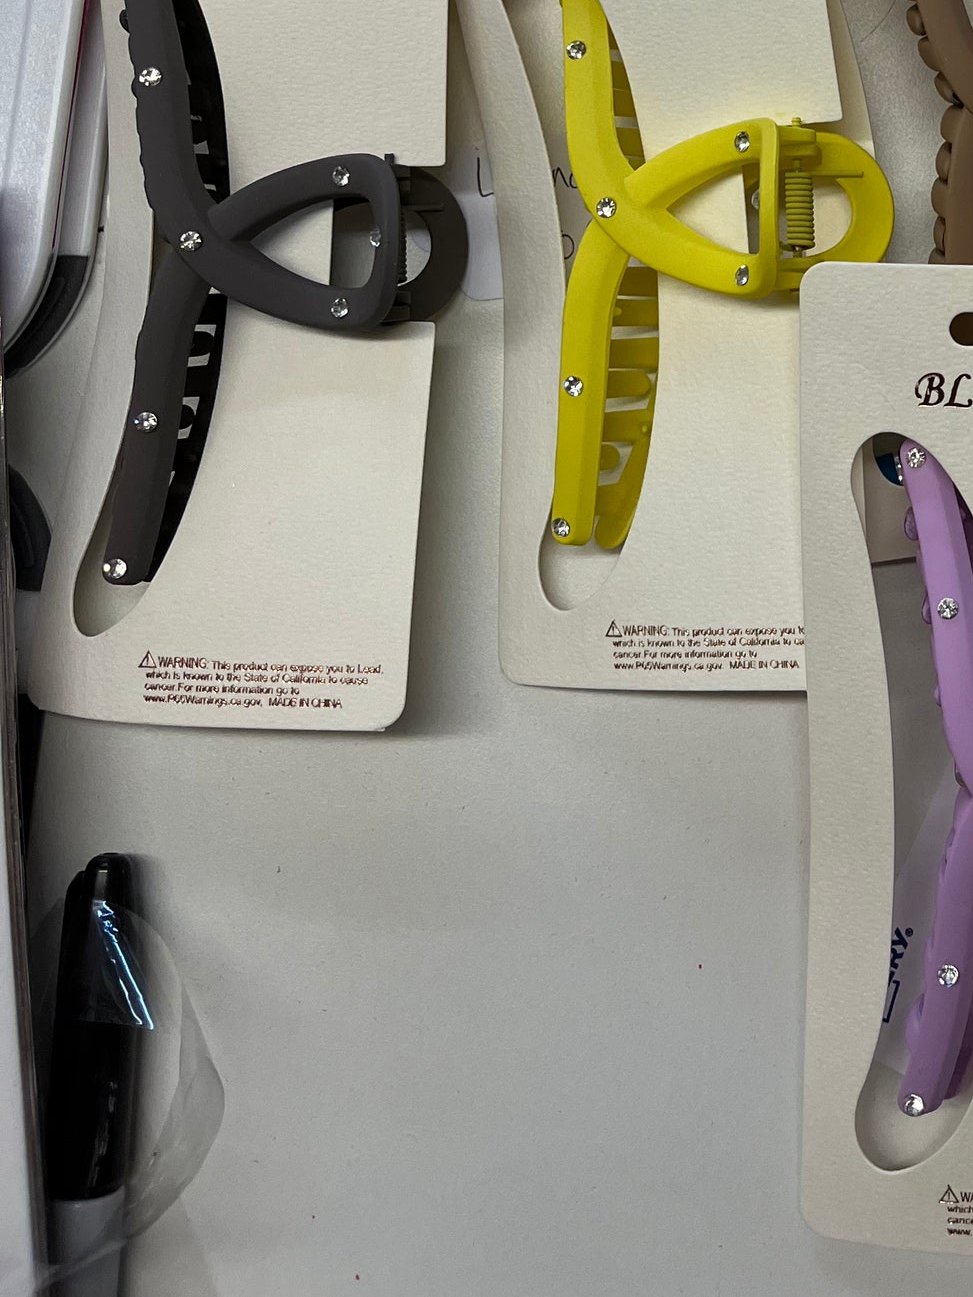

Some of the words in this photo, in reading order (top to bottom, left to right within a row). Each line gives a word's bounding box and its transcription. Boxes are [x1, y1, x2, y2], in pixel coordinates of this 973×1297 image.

[622, 625, 669, 636] WARNING:
[158, 656, 209, 669] WARNING:
[212, 660, 230, 670] This
[233, 662, 268, 672] product
[271, 663, 287, 672] can
[290, 663, 323, 673] expose
[326, 665, 343, 675] you
[346, 665, 354, 673] to
[146, 671, 171, 679] which
[173, 671, 181, 680] is
[183, 671, 212, 681] known
[215, 672, 224, 681] to
[227, 672, 240, 682] the
[244, 673, 268, 682] State
[271, 674, 280, 683] of
[282, 673, 325, 684] California
[328, 676, 337, 684] to
[340, 676, 368, 685] cause
[196, 684, 219, 693] more
[222, 684, 273, 694] information
[276, 687, 288, 696] go
[291, 687, 299, 695] to
[269, 698, 297, 707] MADE
[299, 698, 309, 708] IN
[311, 698, 342, 708] CHINA
[947, 1206, 973, 1214] which
